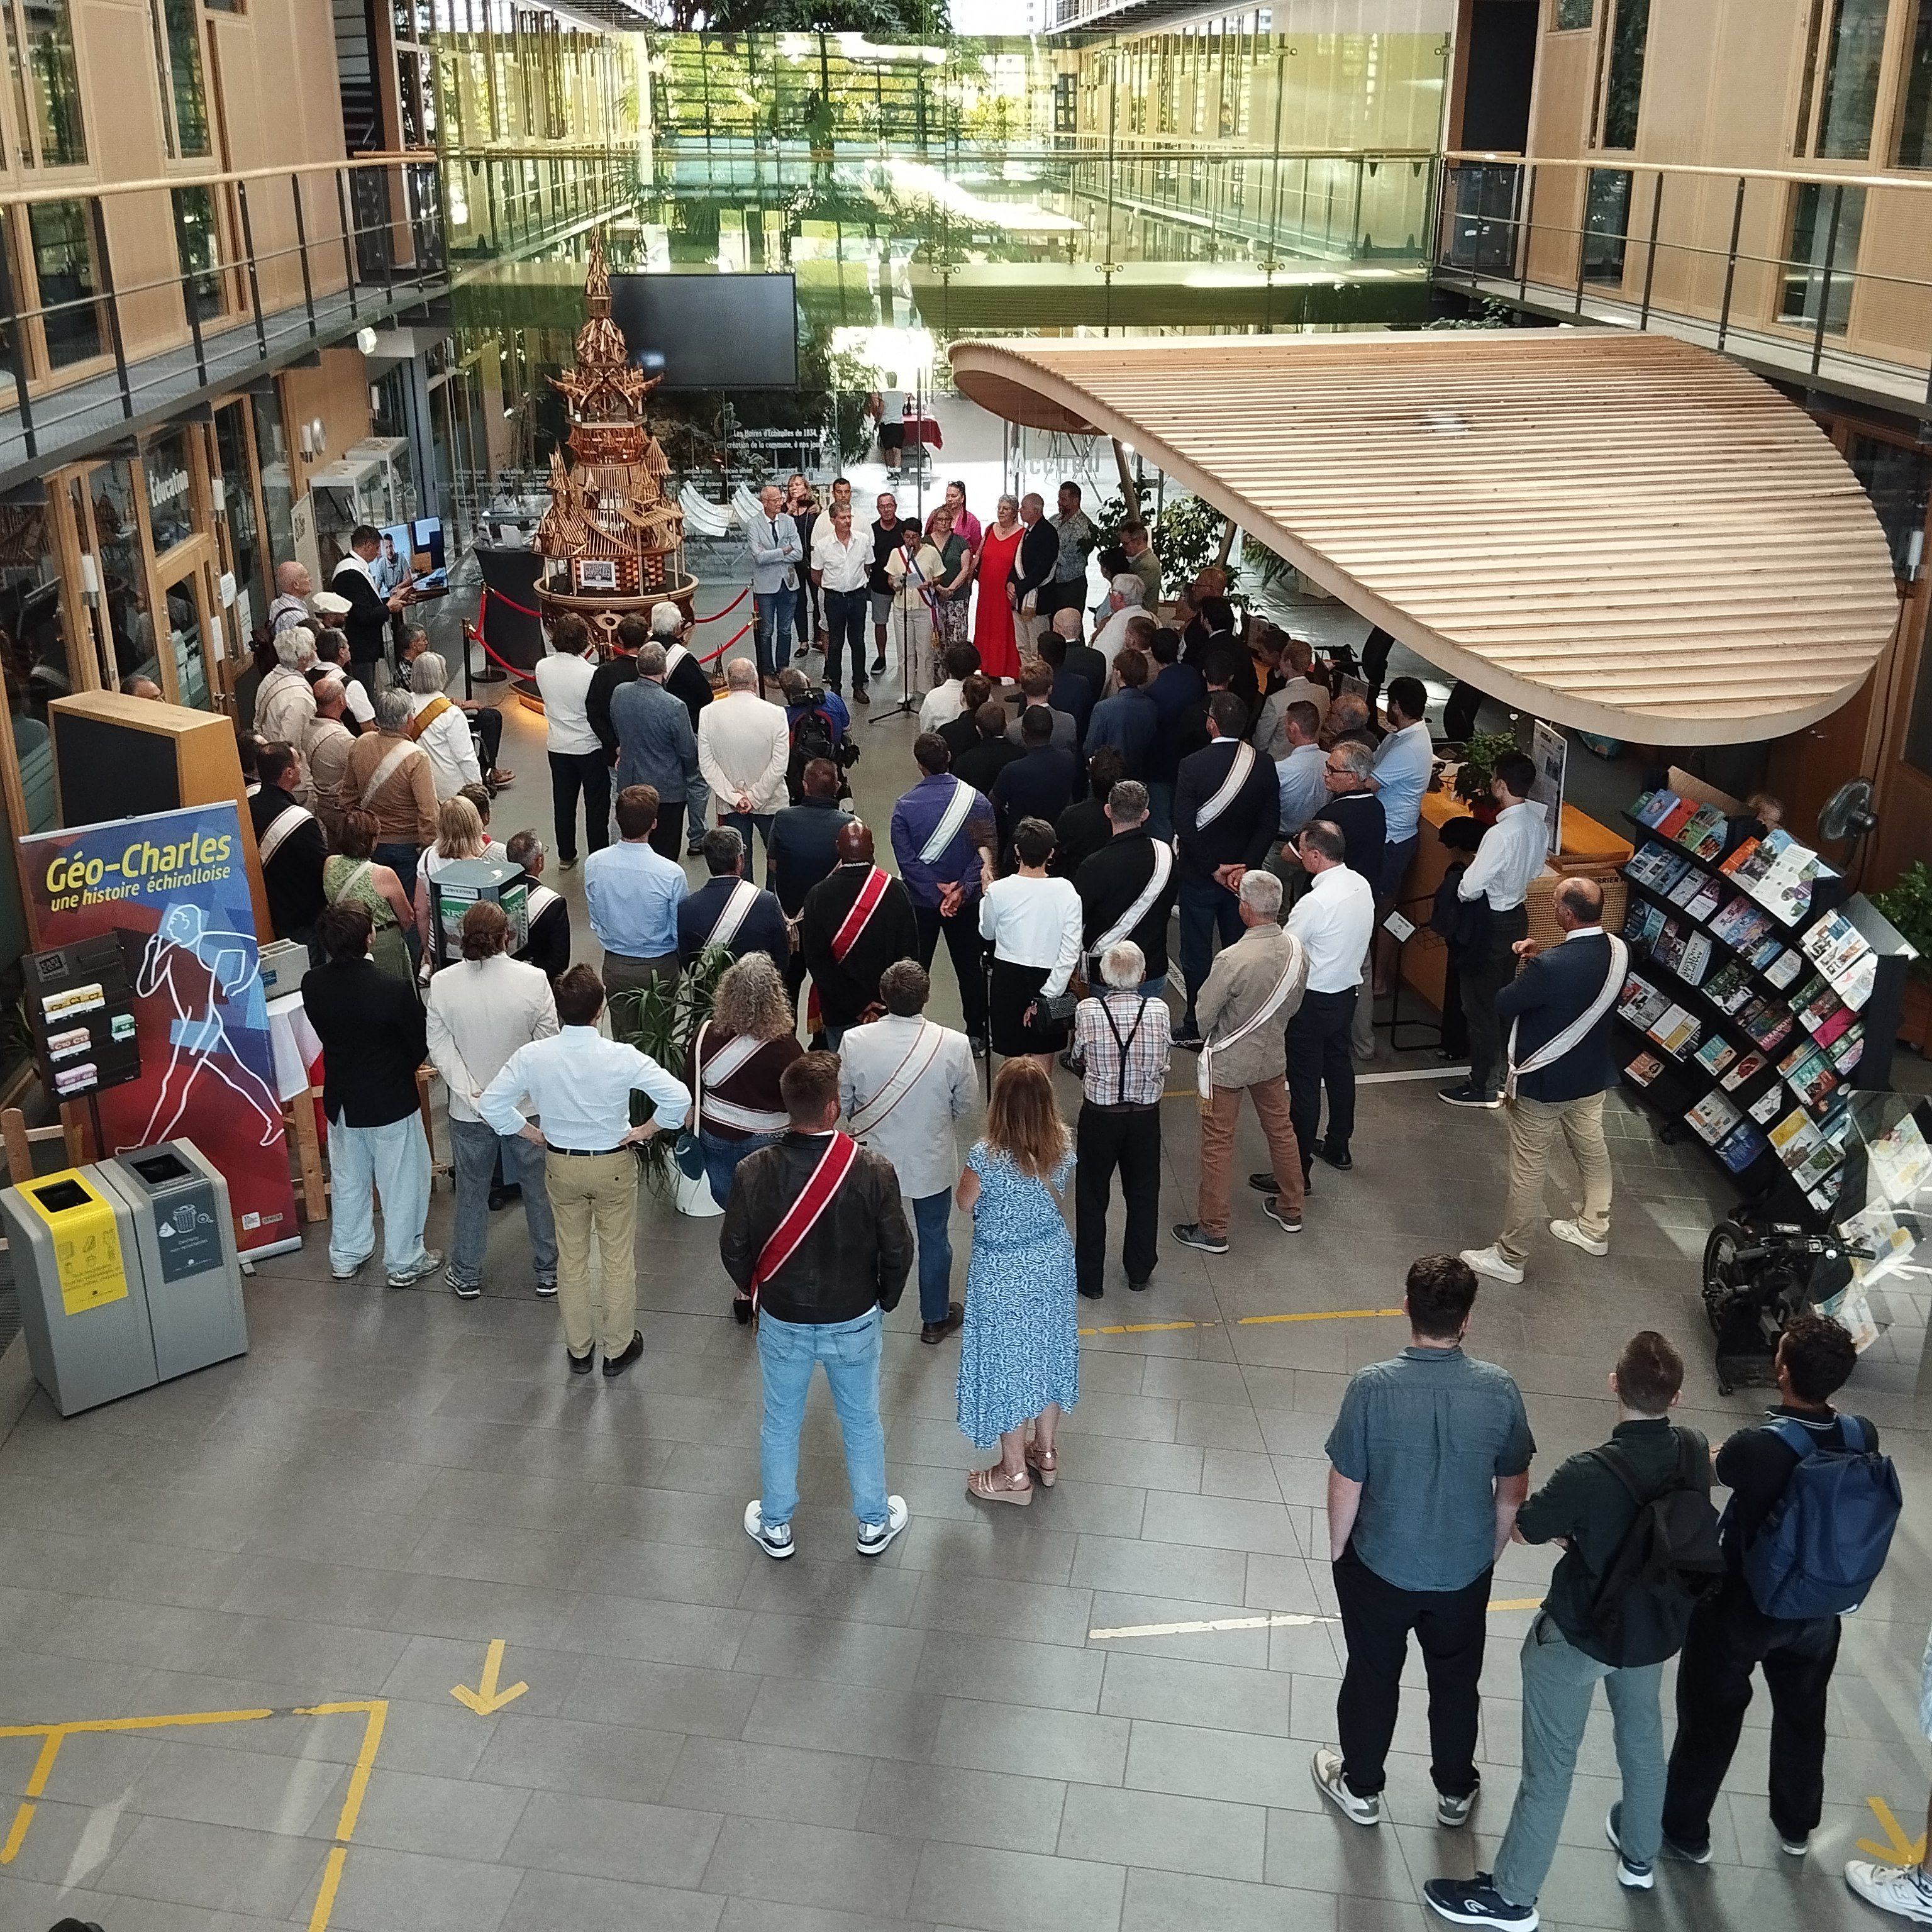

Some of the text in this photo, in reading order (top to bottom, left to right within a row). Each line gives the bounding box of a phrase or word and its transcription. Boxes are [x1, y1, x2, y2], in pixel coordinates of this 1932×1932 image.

[795, 428, 802, 437] de
[758, 440, 765, 448] la
[1011, 447, 1101, 476] Accueil
[46, 833, 232, 893] Géo-Charles
[50, 865, 231, 913] une histoire échirolloise
[69, 996, 82, 1005] C3
